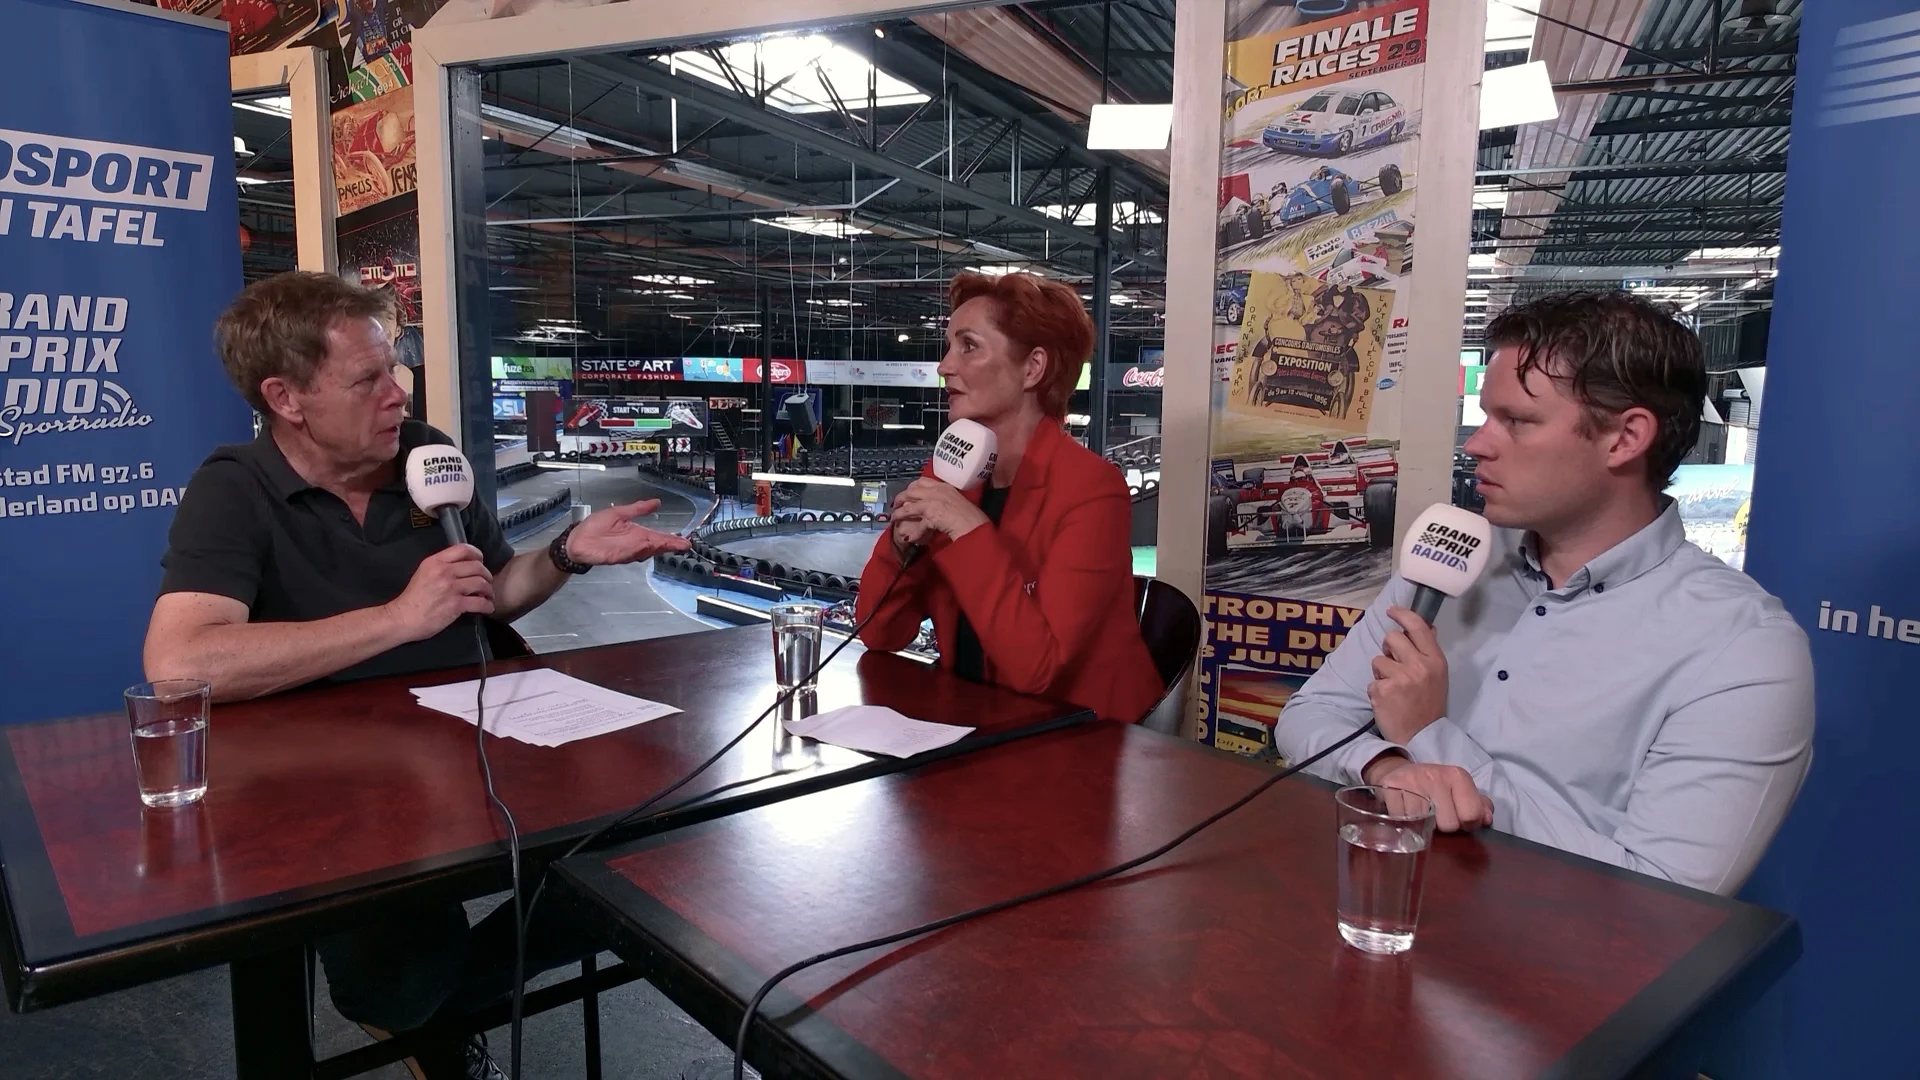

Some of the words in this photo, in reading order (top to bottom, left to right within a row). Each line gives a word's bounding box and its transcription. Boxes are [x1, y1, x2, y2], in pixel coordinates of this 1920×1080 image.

[1273, 8, 1419, 66] FINALE
[1271, 44, 1381, 88] RACES
[1387, 39, 1421, 61] 29
[1348, 61, 1407, 80] SEPTEMBER
[338, 178, 372, 201] PNEUS
[28, 200, 164, 247] TAFEL
[1274, 338, 1301, 348] CONCOURS
[0, 336, 122, 372] PRIX
[1278, 355, 1332, 372] EXPOSITION
[581, 360, 627, 371] STATE
[642, 360, 674, 372] ART
[1314, 394, 1328, 405] 1896
[612, 406, 630, 414] START
[641, 406, 659, 414] FINISH
[943, 432, 974, 452] GRAND
[945, 442, 968, 459] PRIX
[423, 456, 462, 467] GRAND
[935, 448, 959, 466] RADIO
[0, 464, 50, 487] tad
[57, 463, 95, 484] FM
[101, 462, 154, 485] 97.6
[438, 464, 463, 474] PRIX
[425, 473, 460, 487] RADIO
[104, 494, 135, 514] op
[1426, 522, 1481, 548] GRAND
[1411, 543, 1460, 568] RADIO
[1434, 538, 1474, 559] PRIX
[1202, 595, 1363, 628] TROPHY
[1818, 600, 1858, 634] in
